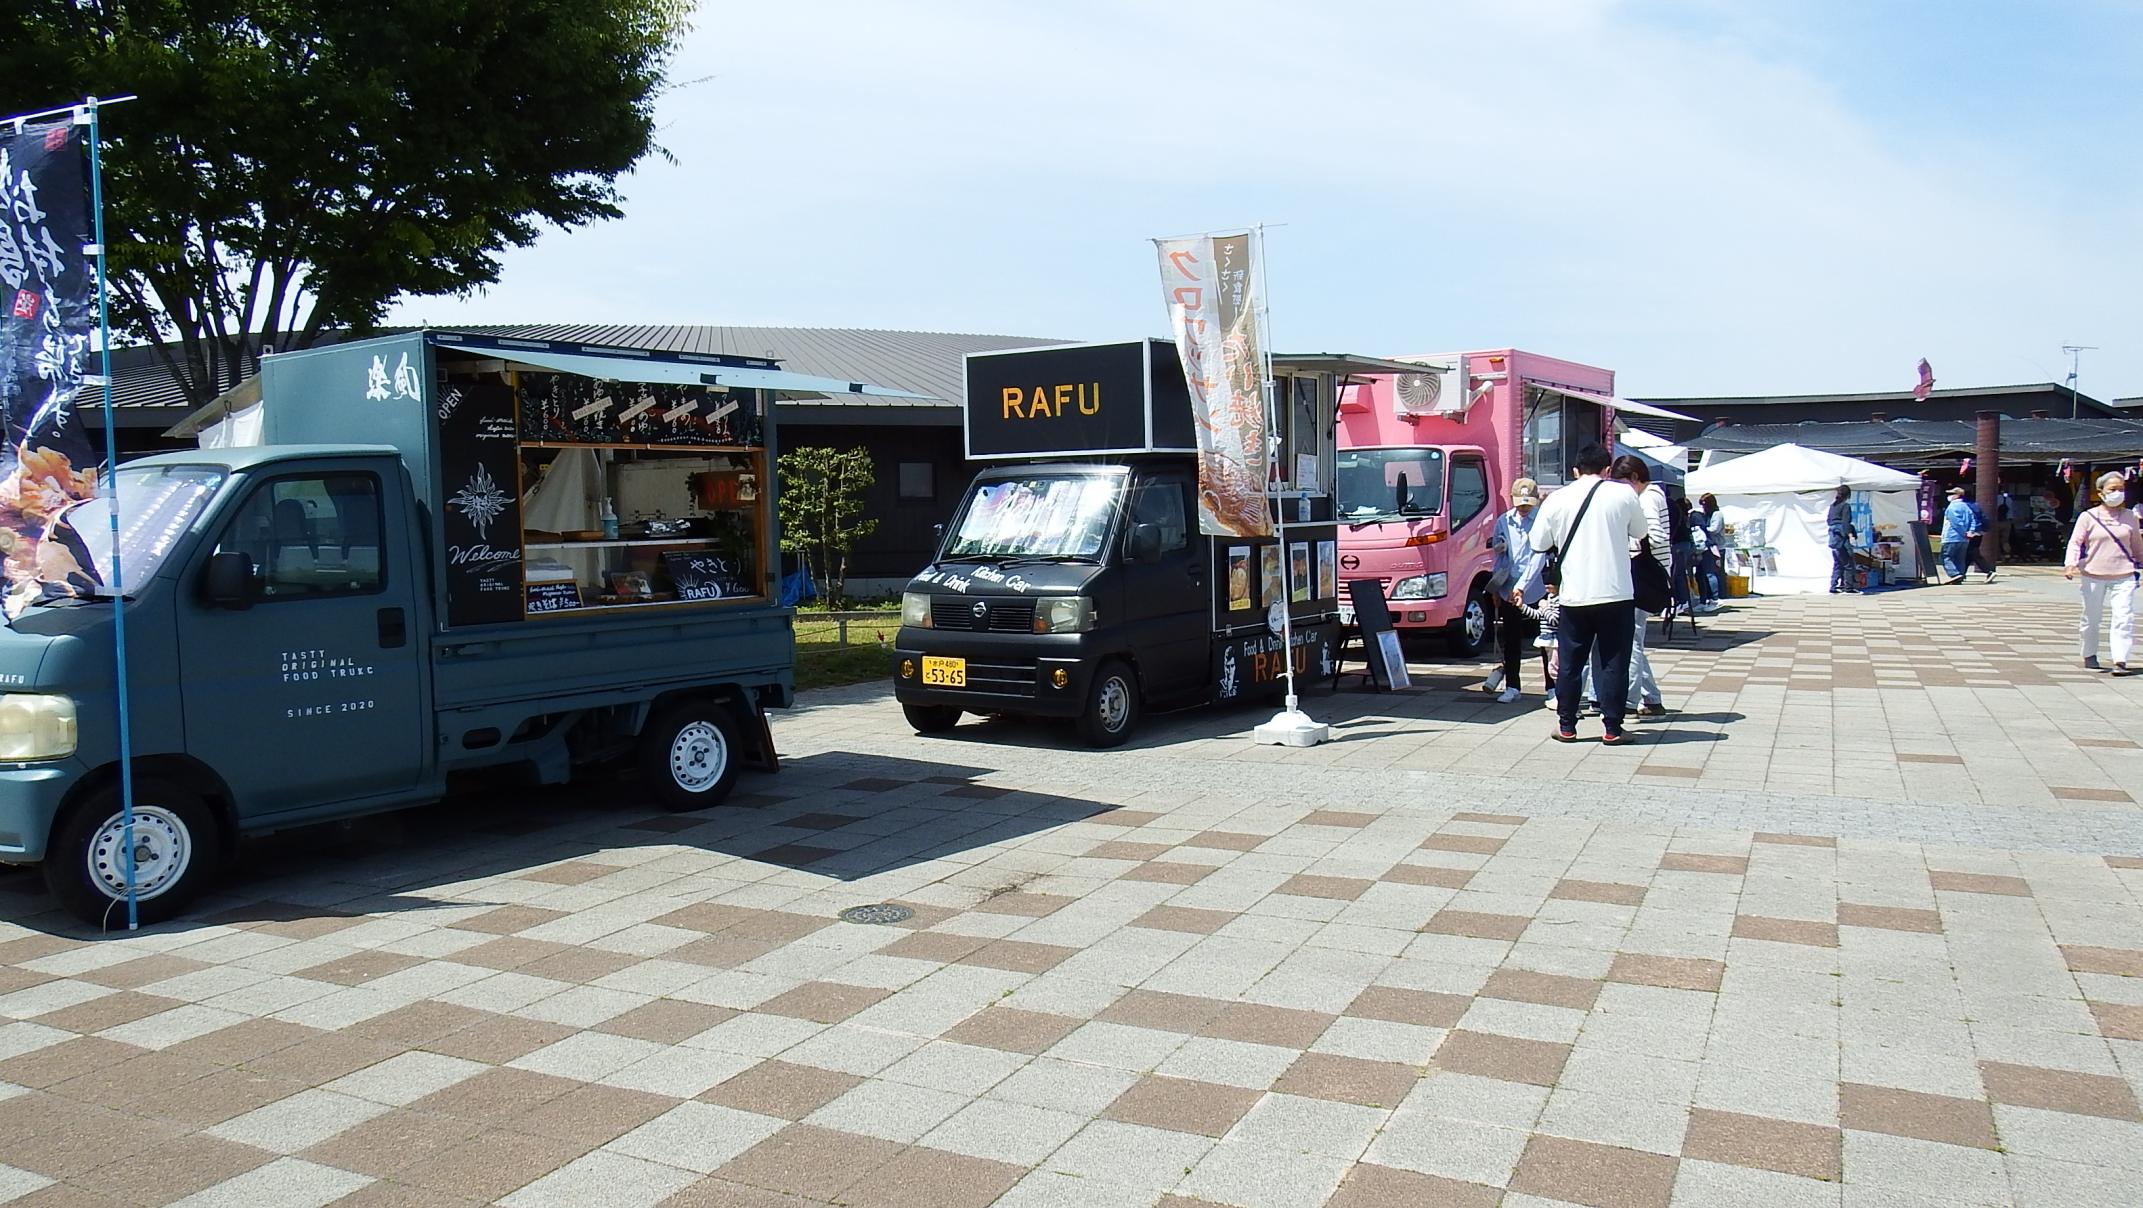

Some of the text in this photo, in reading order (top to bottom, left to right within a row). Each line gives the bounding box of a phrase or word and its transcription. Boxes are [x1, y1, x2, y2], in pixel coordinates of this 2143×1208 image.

[438, 388, 463, 420] OPEN
[1003, 383, 1100, 419] RAFU
[449, 544, 521, 565] Welcome
[942, 574, 971, 594] Drink
[1005, 574, 1032, 593] Car
[686, 587, 716, 600] RAFU
[1306, 629, 1318, 643] Car
[1243, 640, 1257, 657] Food
[282, 658, 354, 672] ORIGINAL
[1255, 647, 1307, 682] RAU
[283, 671, 318, 682] FOOD
[287, 700, 374, 718] SINCE 2020
